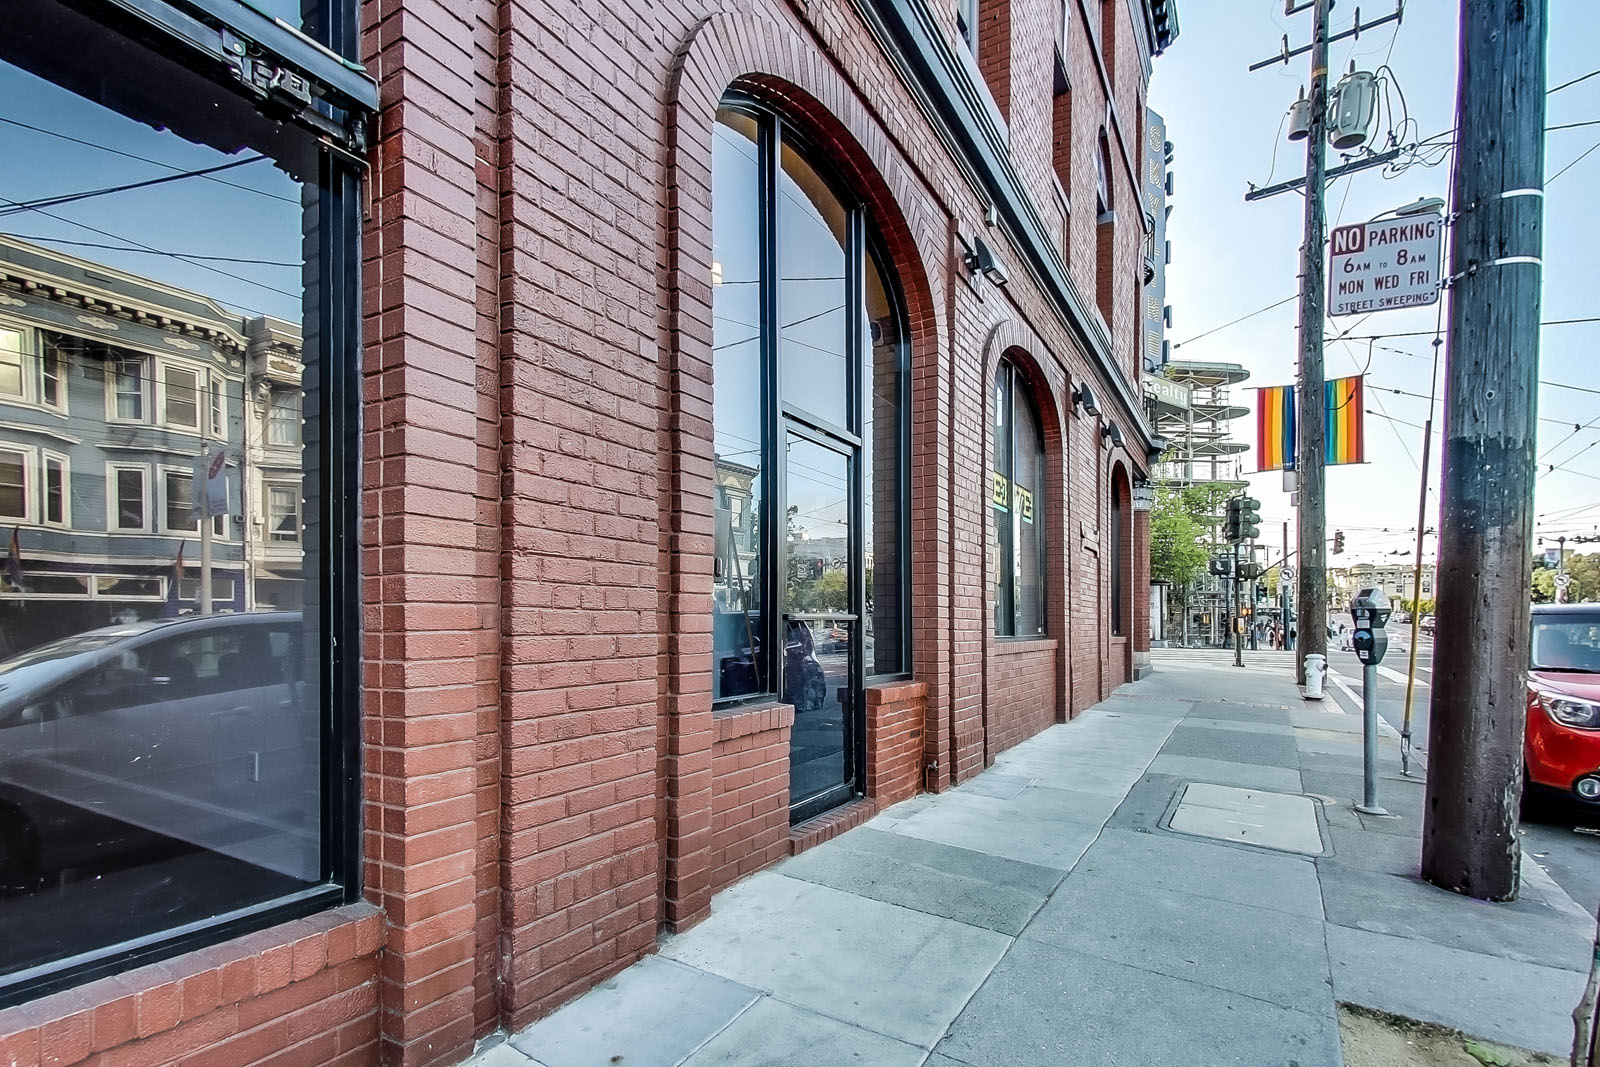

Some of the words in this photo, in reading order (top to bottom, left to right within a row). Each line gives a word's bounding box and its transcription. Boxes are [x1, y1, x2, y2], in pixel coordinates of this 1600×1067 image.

[1335, 227, 1361, 253] NO
[1368, 221, 1435, 247] PARKING
[1379, 261, 1388, 269] TO
[1338, 279, 1364, 295] MON
[1374, 274, 1399, 291] WED
[1409, 270, 1430, 286] FRI
[1338, 299, 1374, 312] STREET
[1379, 292, 1429, 307] SWEEPING
